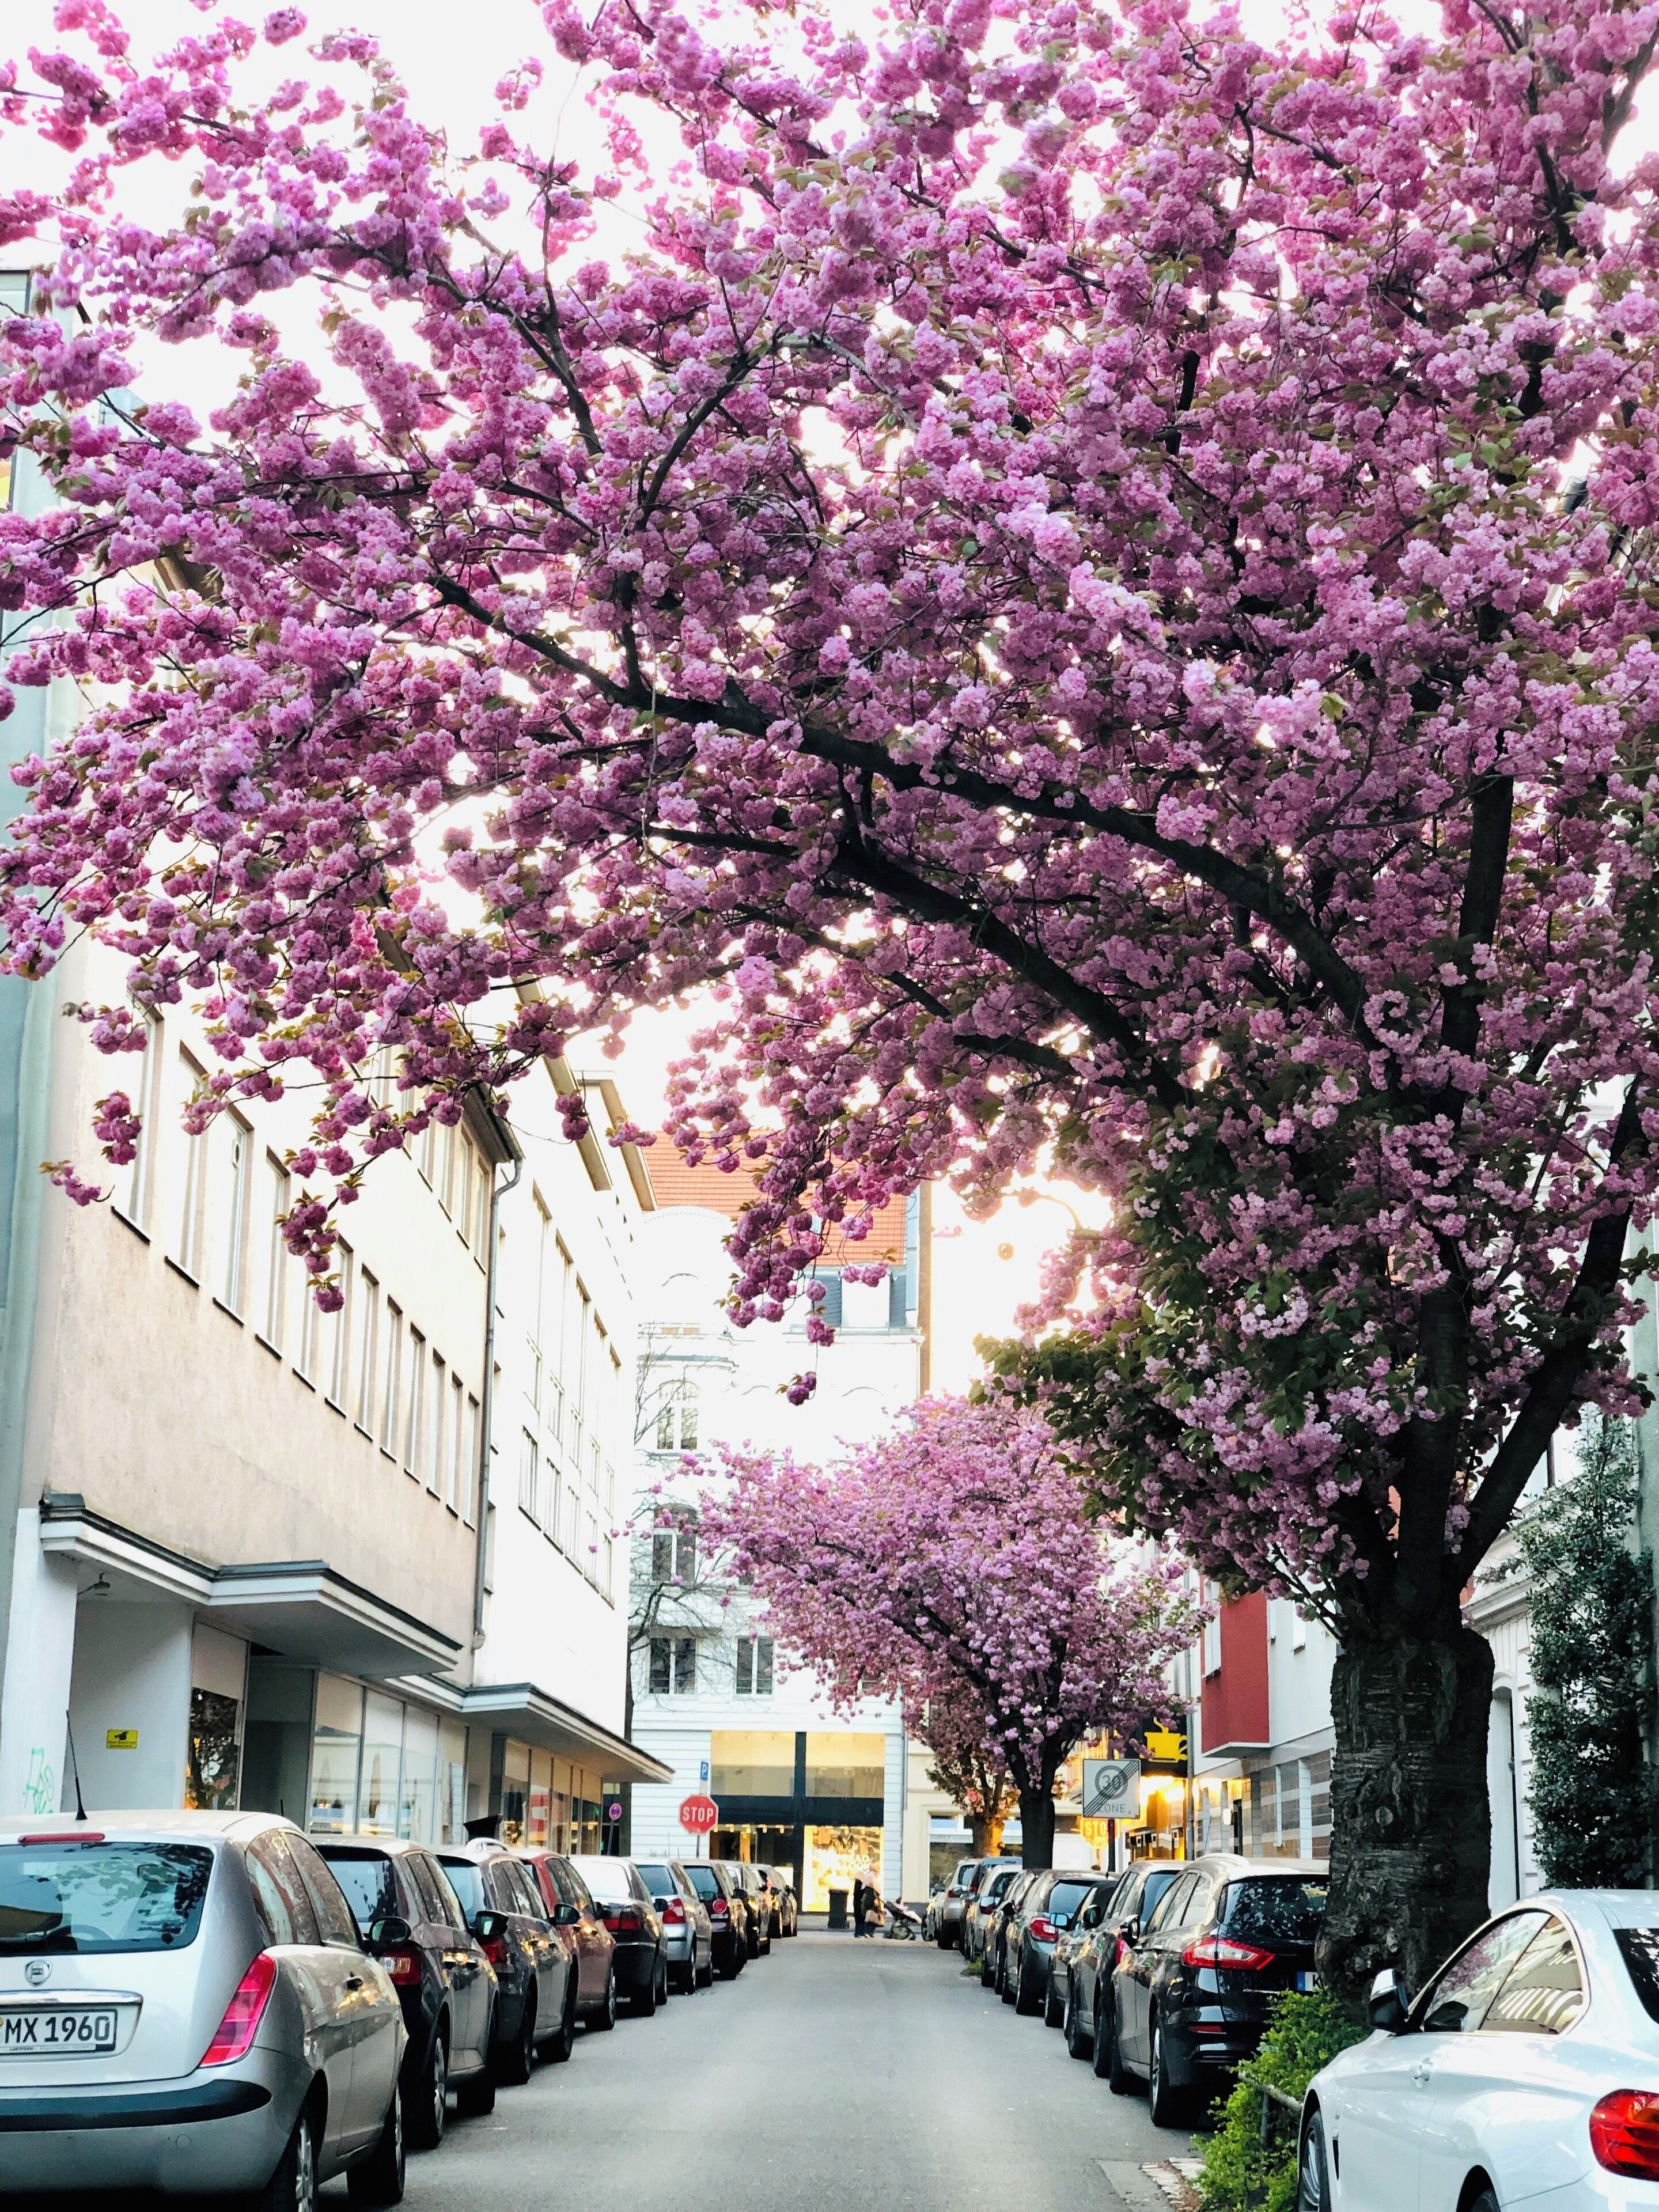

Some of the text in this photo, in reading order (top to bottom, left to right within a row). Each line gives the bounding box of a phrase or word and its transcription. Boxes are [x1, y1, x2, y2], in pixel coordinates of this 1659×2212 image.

[683, 1806, 714, 1823] STOP
[1085, 1821, 1107, 1836] STO
[5, 2016, 110, 2043] MX 1960
